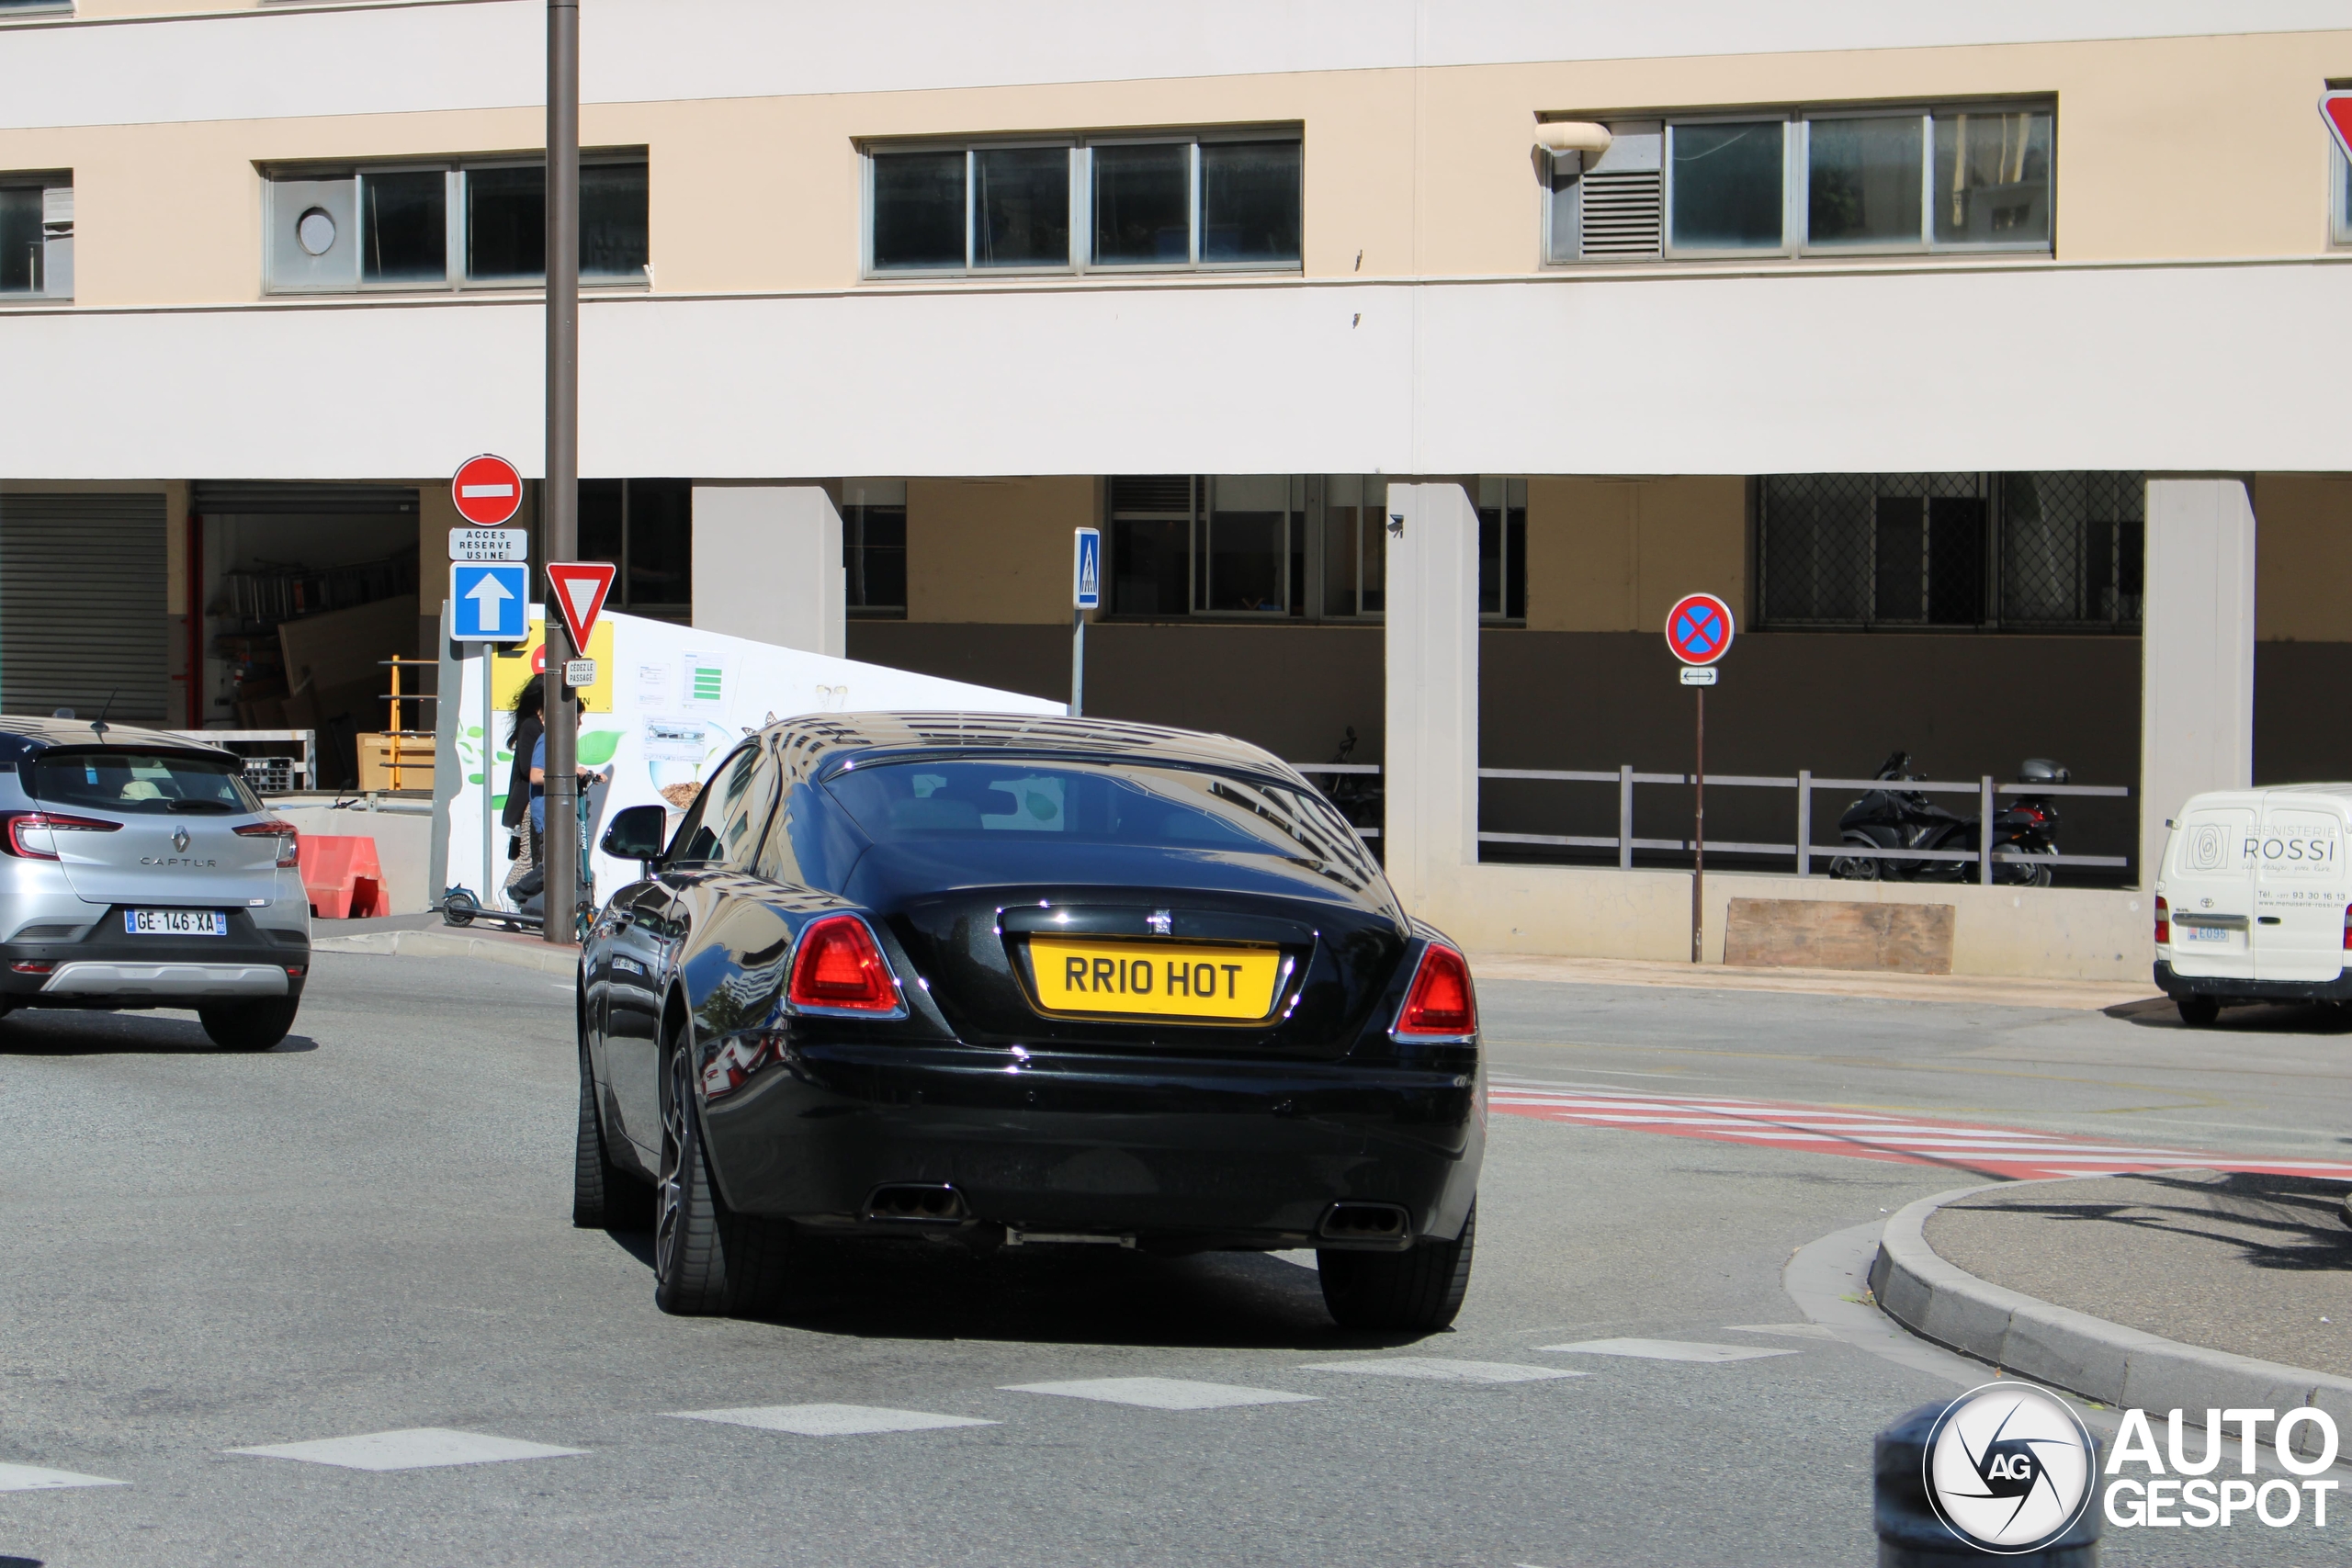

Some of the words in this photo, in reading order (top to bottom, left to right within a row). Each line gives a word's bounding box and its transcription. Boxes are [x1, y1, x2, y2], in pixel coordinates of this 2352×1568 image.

[466, 531, 506, 539] ACCES
[459, 541, 512, 549] RESERVE
[467, 551, 504, 559] USINE
[570, 662, 586, 672] CÉDEZ
[587, 663, 594, 671] LE
[570, 673, 593, 682] PASSAGE
[2245, 825, 2336, 838] EBENISTERIE
[2244, 838, 2334, 862] ROSSI
[140, 857, 217, 868] CAPTUR
[2258, 890, 2272, 898] Tél.
[2292, 891, 2304, 899] 93
[2308, 892, 2319, 900] 30
[2336, 893, 2346, 901] 13
[217, 923, 225, 932] 06
[1066, 956, 1153, 995] RR10
[1167, 961, 1243, 1000] HOT
